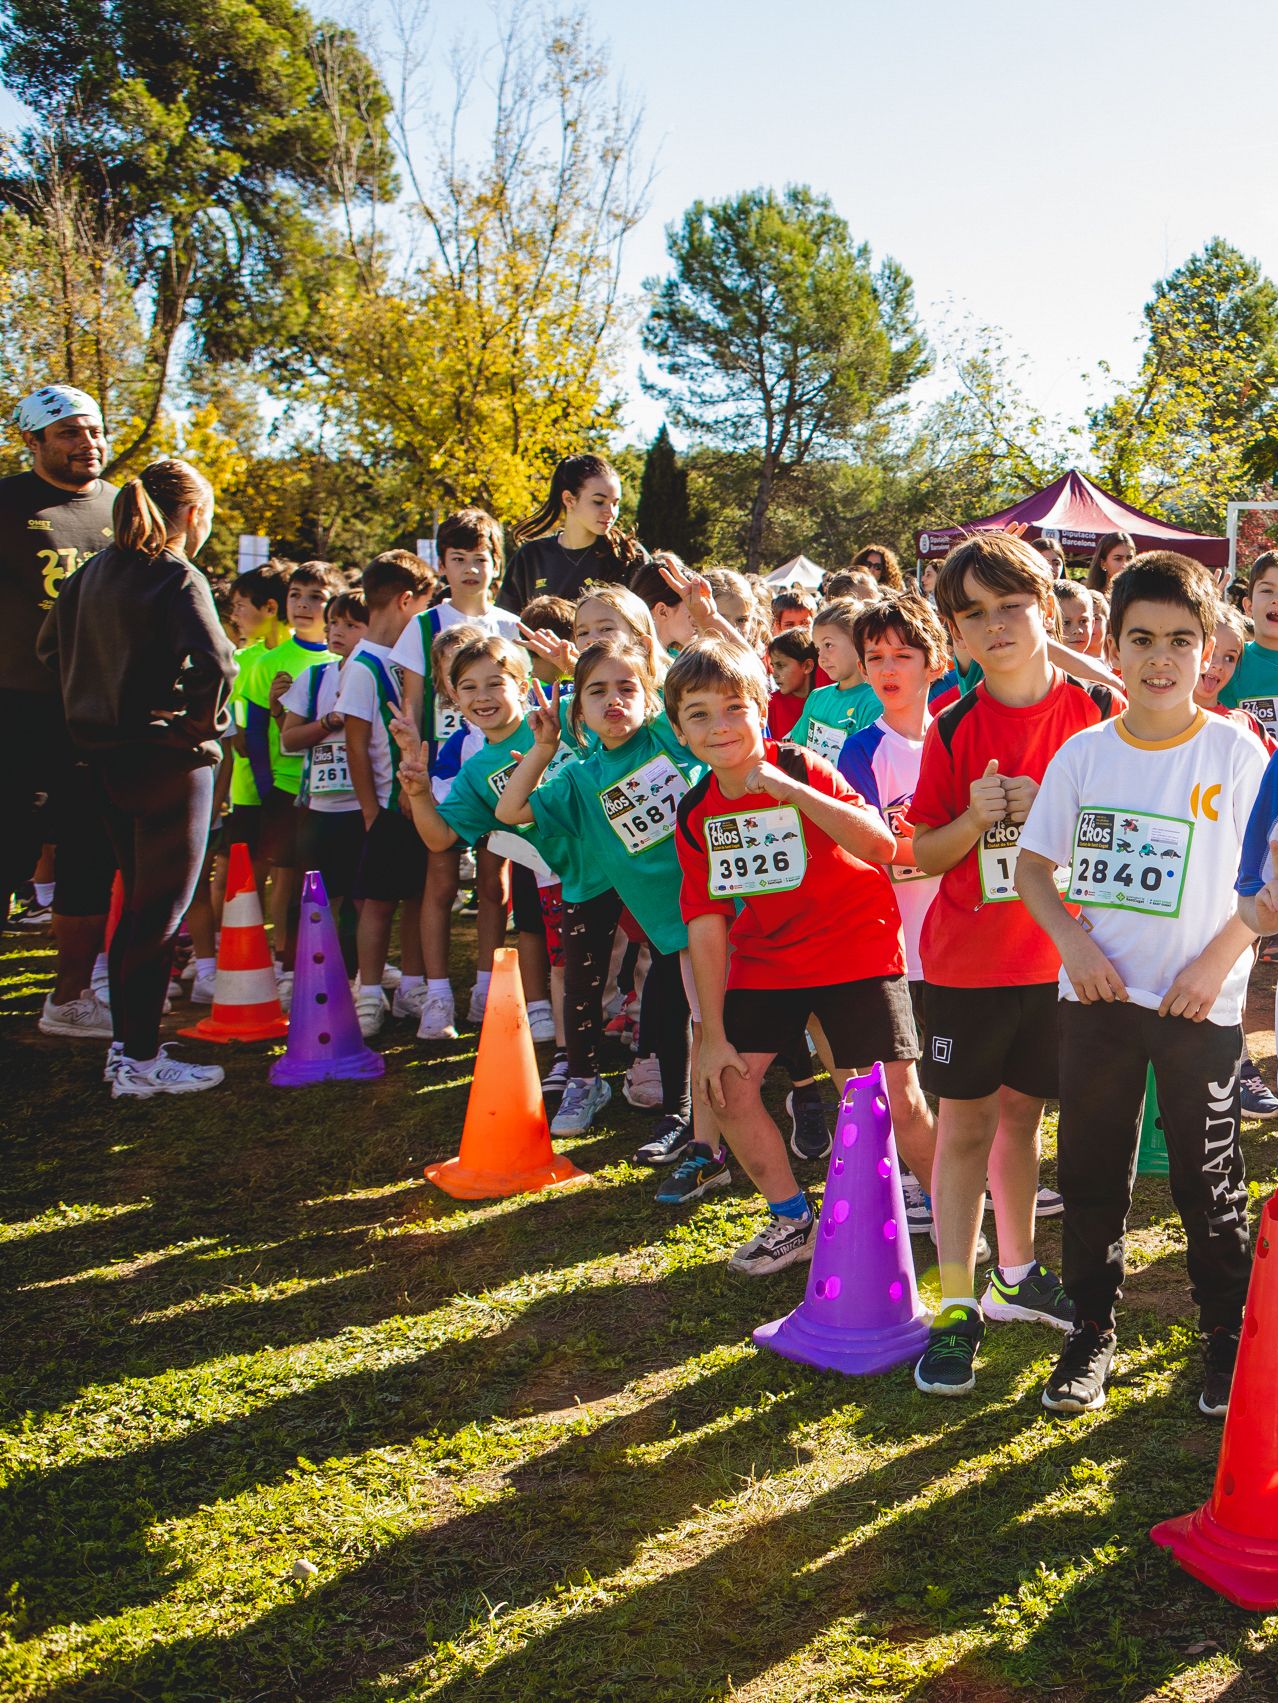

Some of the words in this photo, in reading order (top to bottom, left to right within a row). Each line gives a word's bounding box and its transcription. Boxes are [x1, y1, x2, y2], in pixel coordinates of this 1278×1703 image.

[1061, 530, 1096, 539] Diputació
[1061, 538, 1096, 547] Barcelona
[605, 796, 630, 816] CROS
[622, 793, 677, 838] 1687
[712, 831, 739, 846] CROS
[1080, 827, 1111, 843] CROS
[720, 851, 789, 879] 3926
[1078, 858, 1162, 892] 2840
